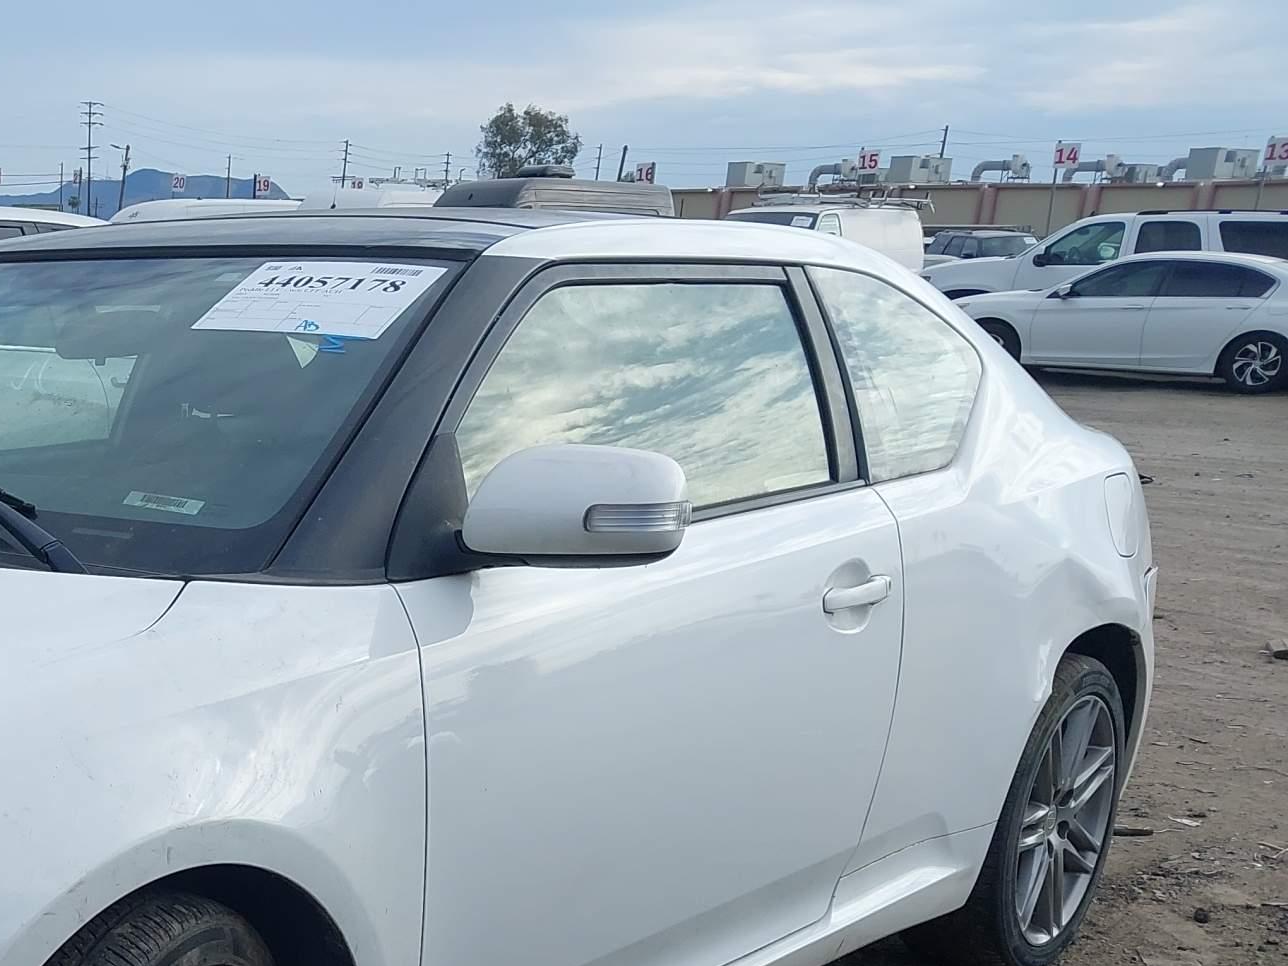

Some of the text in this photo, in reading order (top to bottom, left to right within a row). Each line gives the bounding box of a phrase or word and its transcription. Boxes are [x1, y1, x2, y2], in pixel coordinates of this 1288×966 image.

[1054, 146, 1078, 164] 14
[1264, 143, 1288, 161] 13
[859, 153, 879, 169] 15
[173, 176, 185, 189] 20
[636, 167, 653, 182] 16
[256, 179, 270, 192] 19
[257, 275, 407, 293] 44057178
